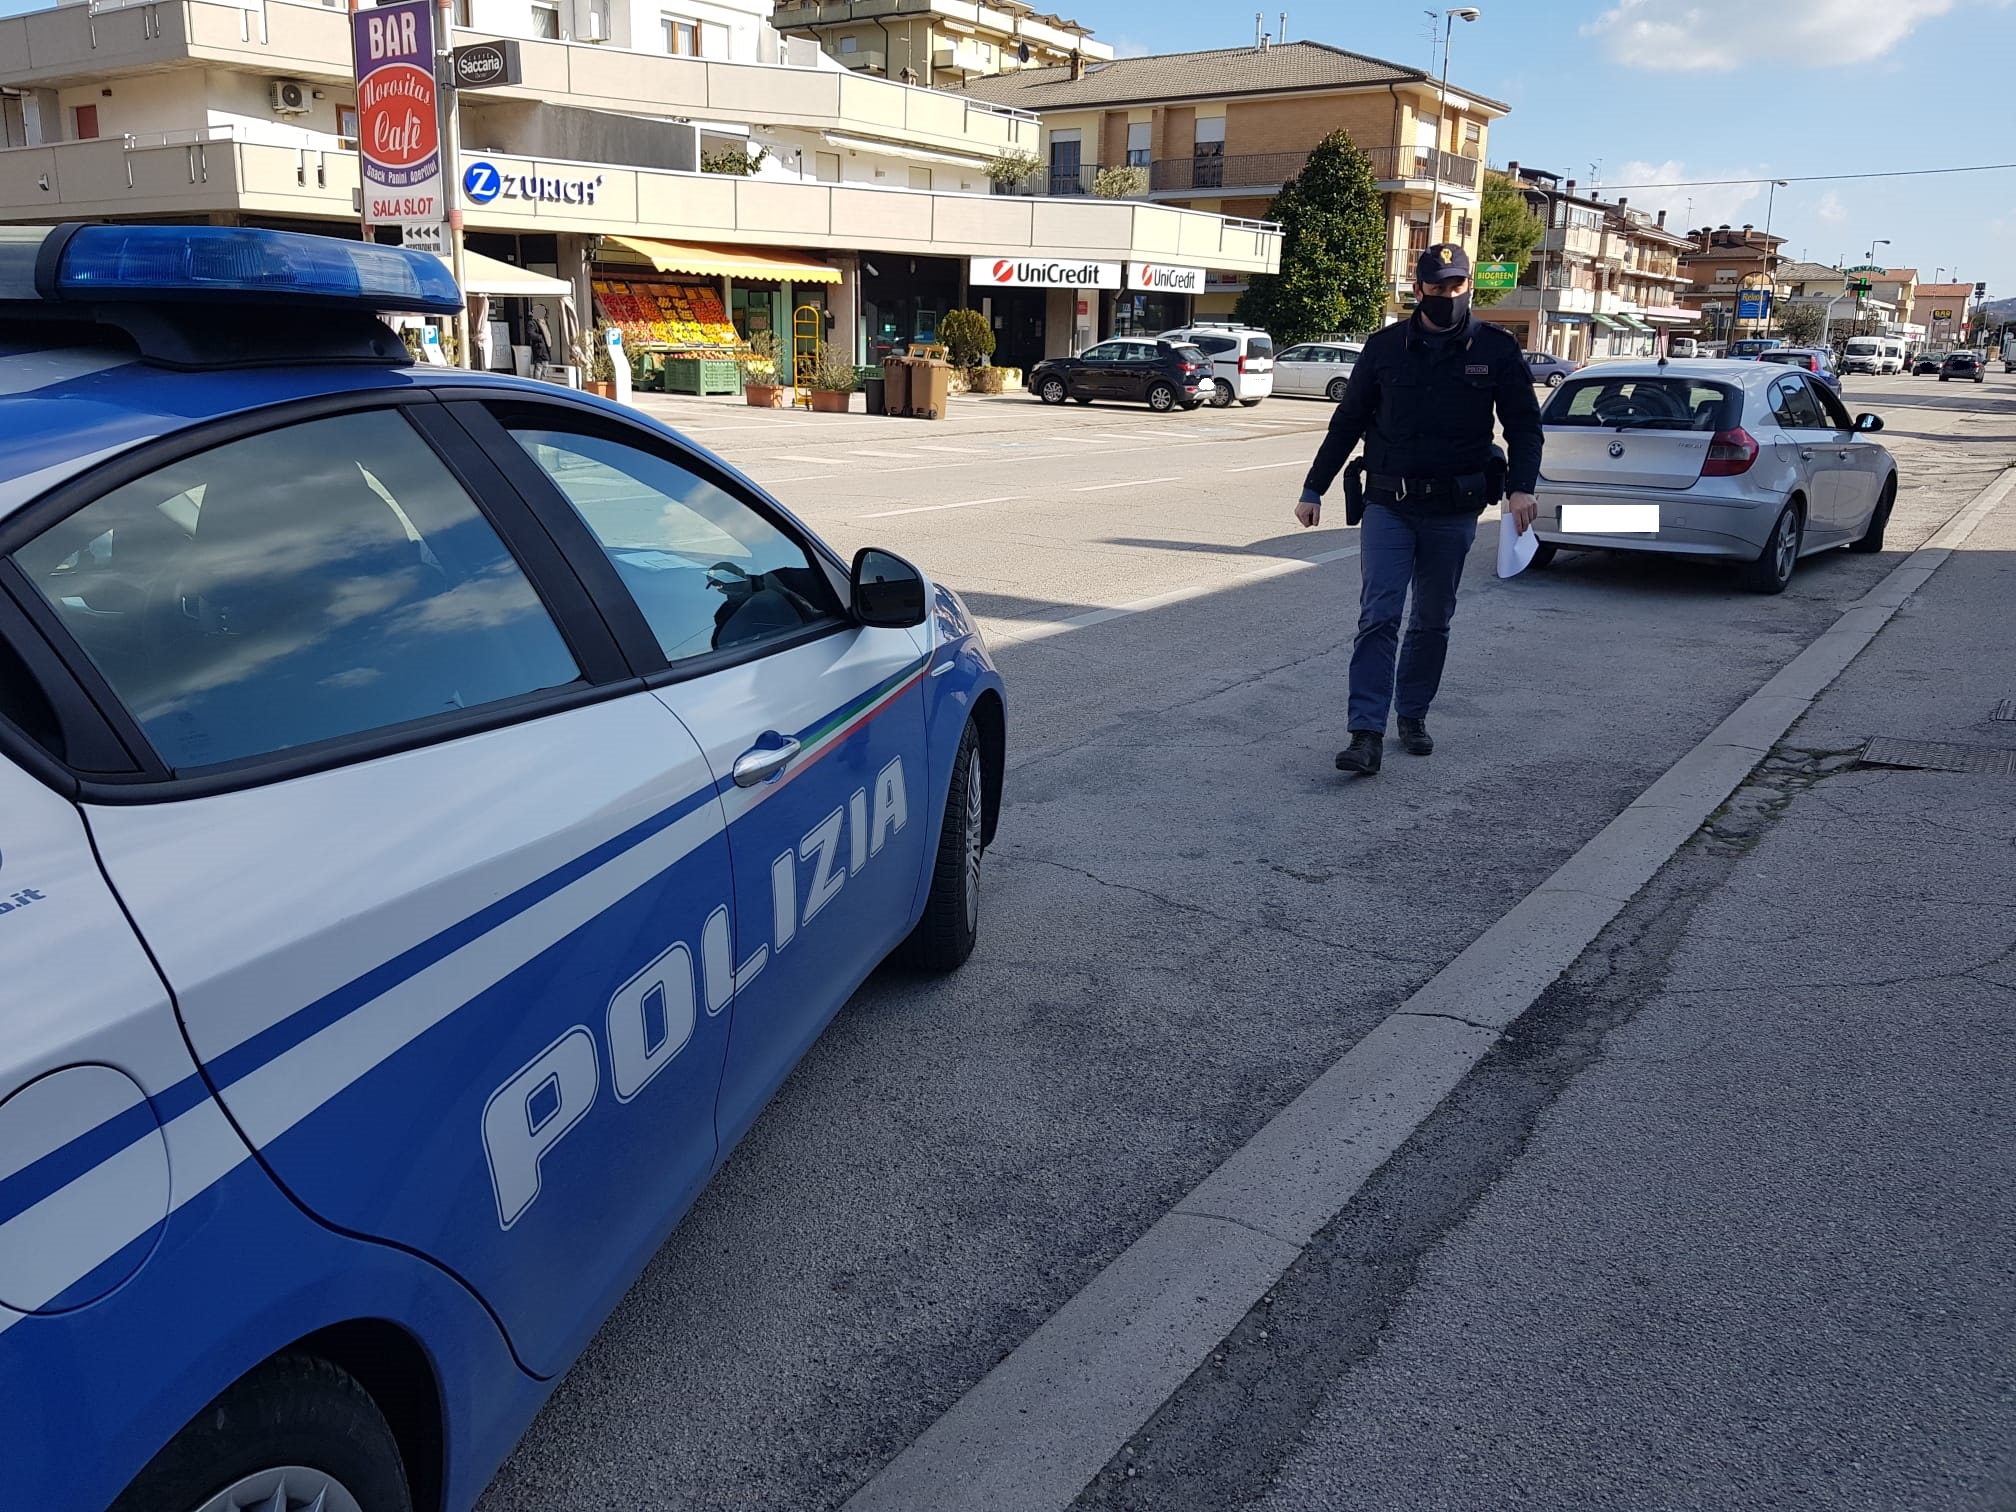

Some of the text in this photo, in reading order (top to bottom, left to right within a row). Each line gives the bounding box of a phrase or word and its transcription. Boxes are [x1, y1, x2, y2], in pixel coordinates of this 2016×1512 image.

[369, 11, 418, 60] BAR
[461, 55, 500, 74] Saccaria
[362, 72, 432, 114] Morositas
[367, 164, 385, 182] Snack
[388, 172, 407, 185] Panini
[503, 174, 598, 205] ZURICH
[373, 197, 433, 217] SALA SLOT
[1017, 262, 1100, 285] UniCredit
[1154, 268, 1195, 289] UniCredit
[1477, 272, 1514, 280] BIOGREEN
[1843, 265, 1887, 276] FARMACIA
[481, 755, 908, 1231] POLIZIA
